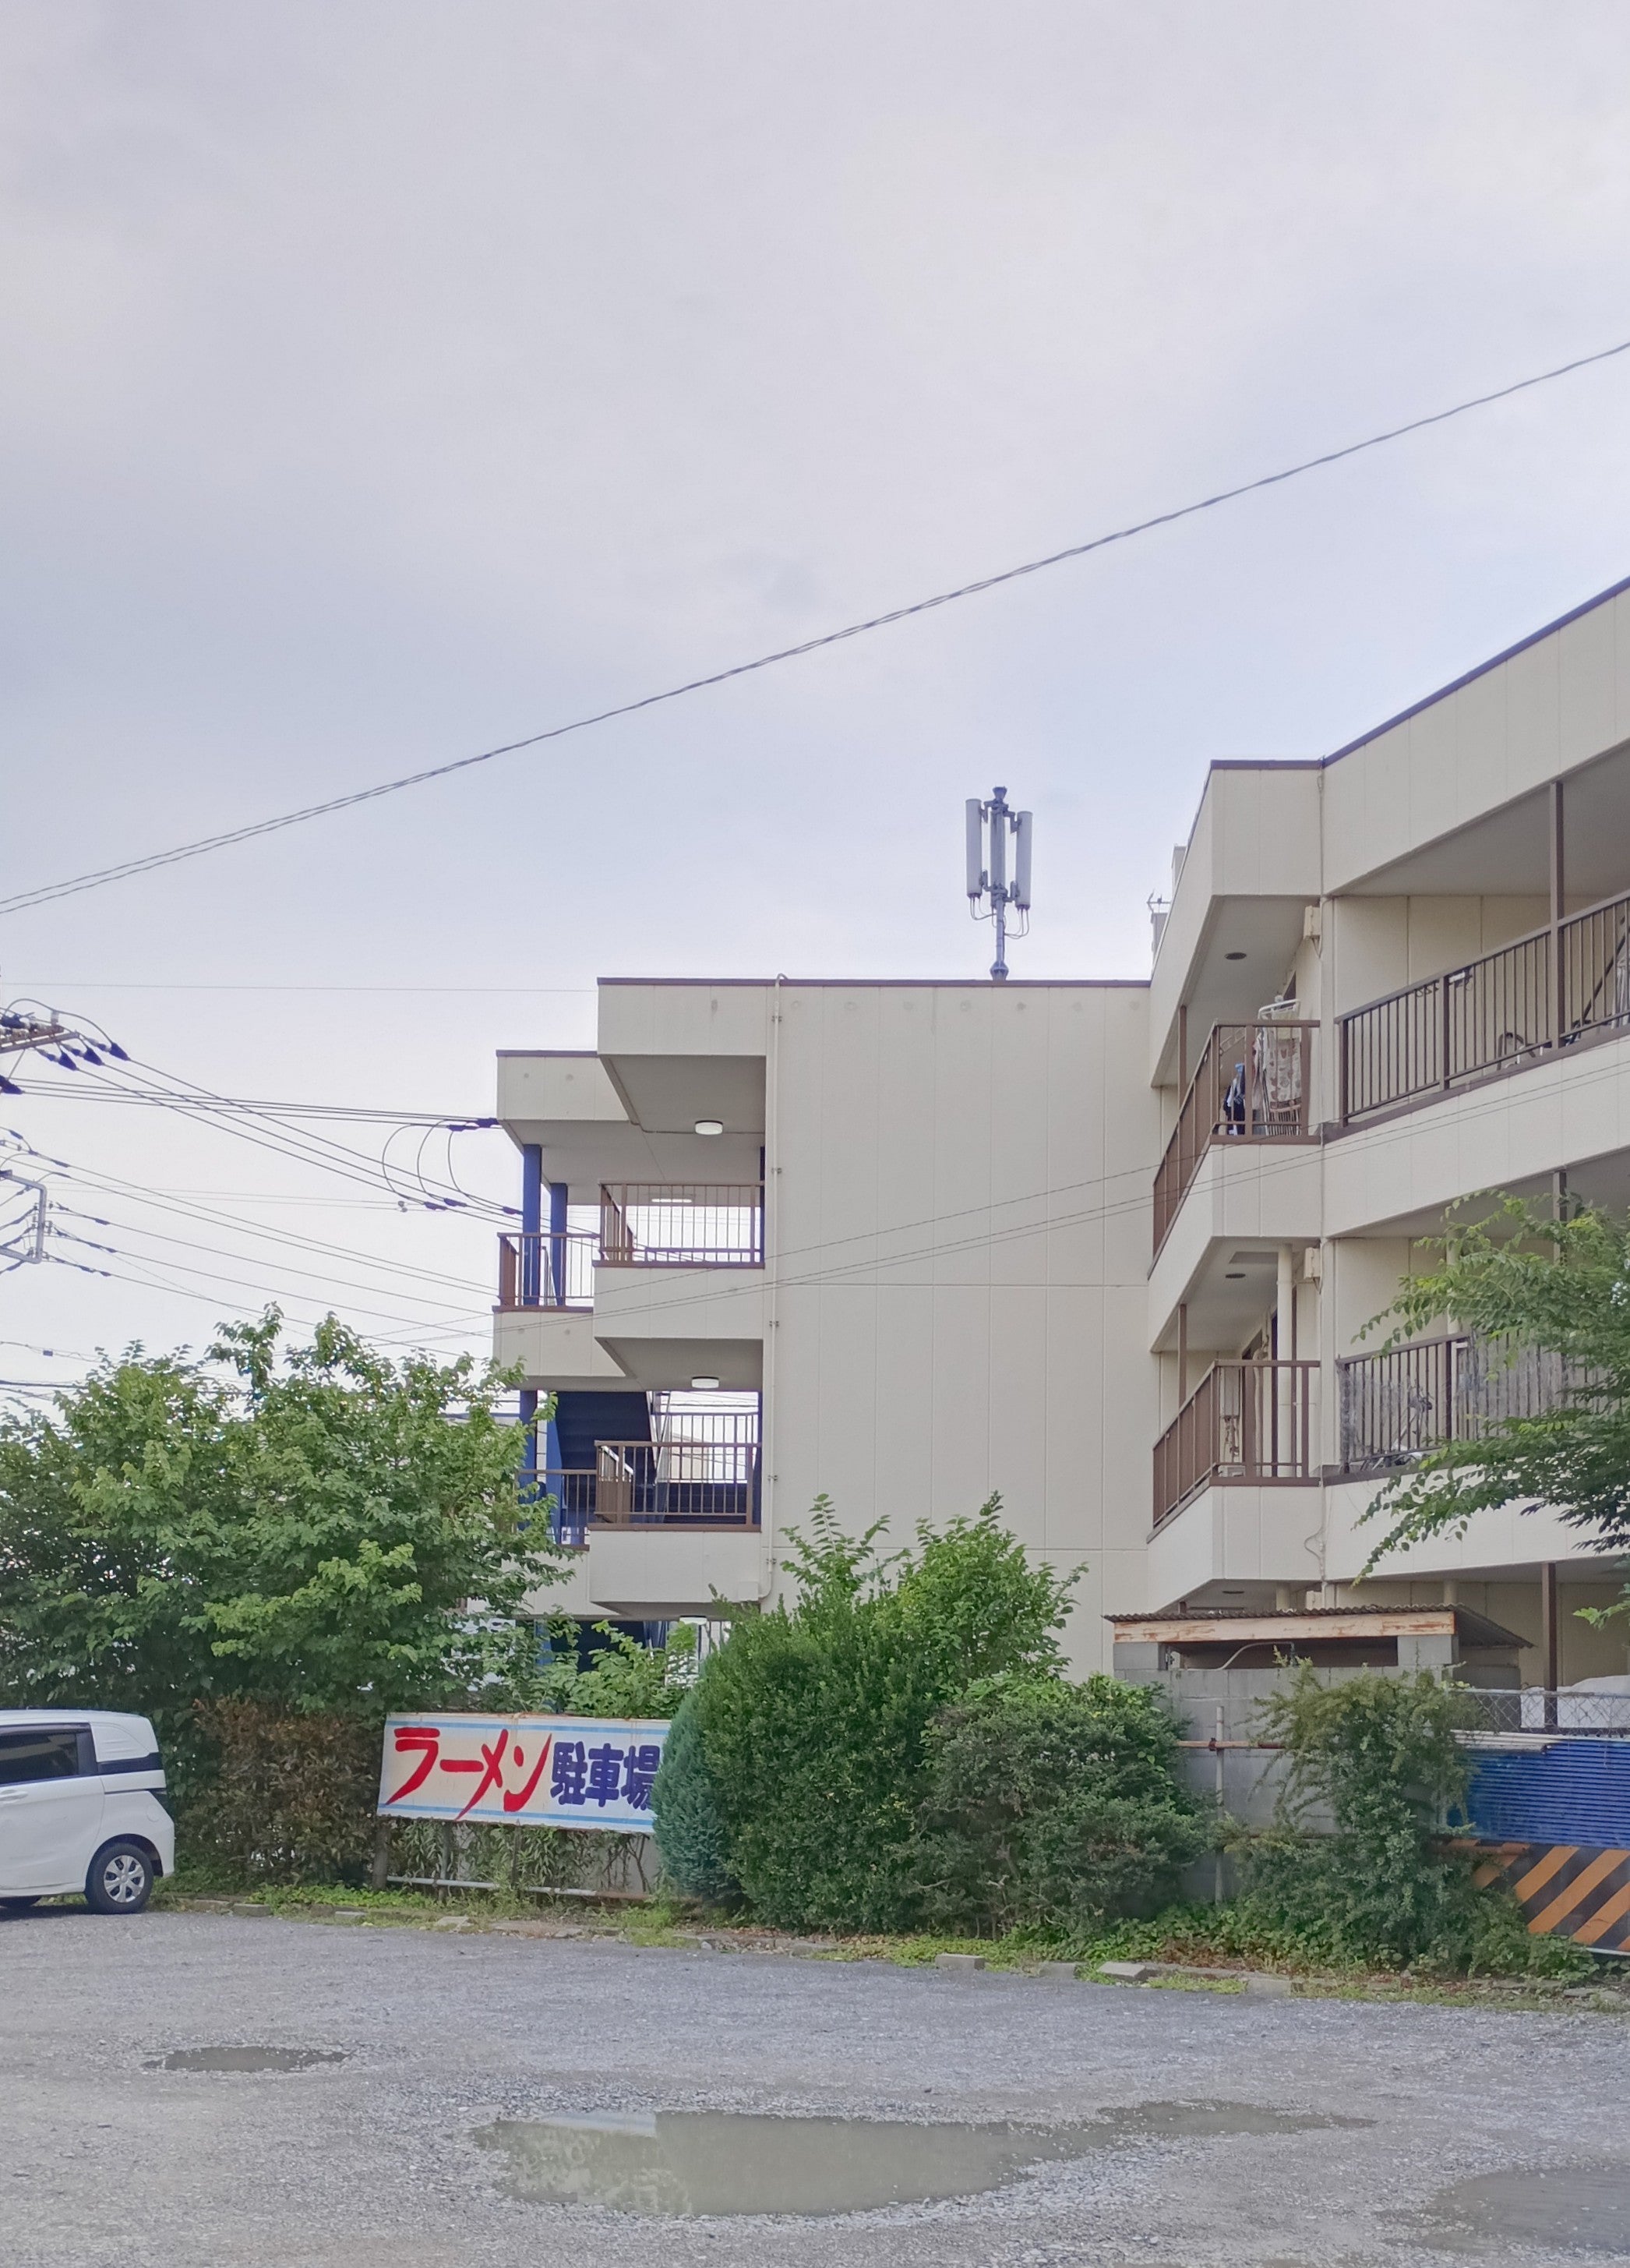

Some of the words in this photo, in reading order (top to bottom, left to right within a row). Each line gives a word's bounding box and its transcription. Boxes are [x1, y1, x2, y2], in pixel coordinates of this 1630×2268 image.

[386, 1726, 660, 1821] ラーメン駐車場
